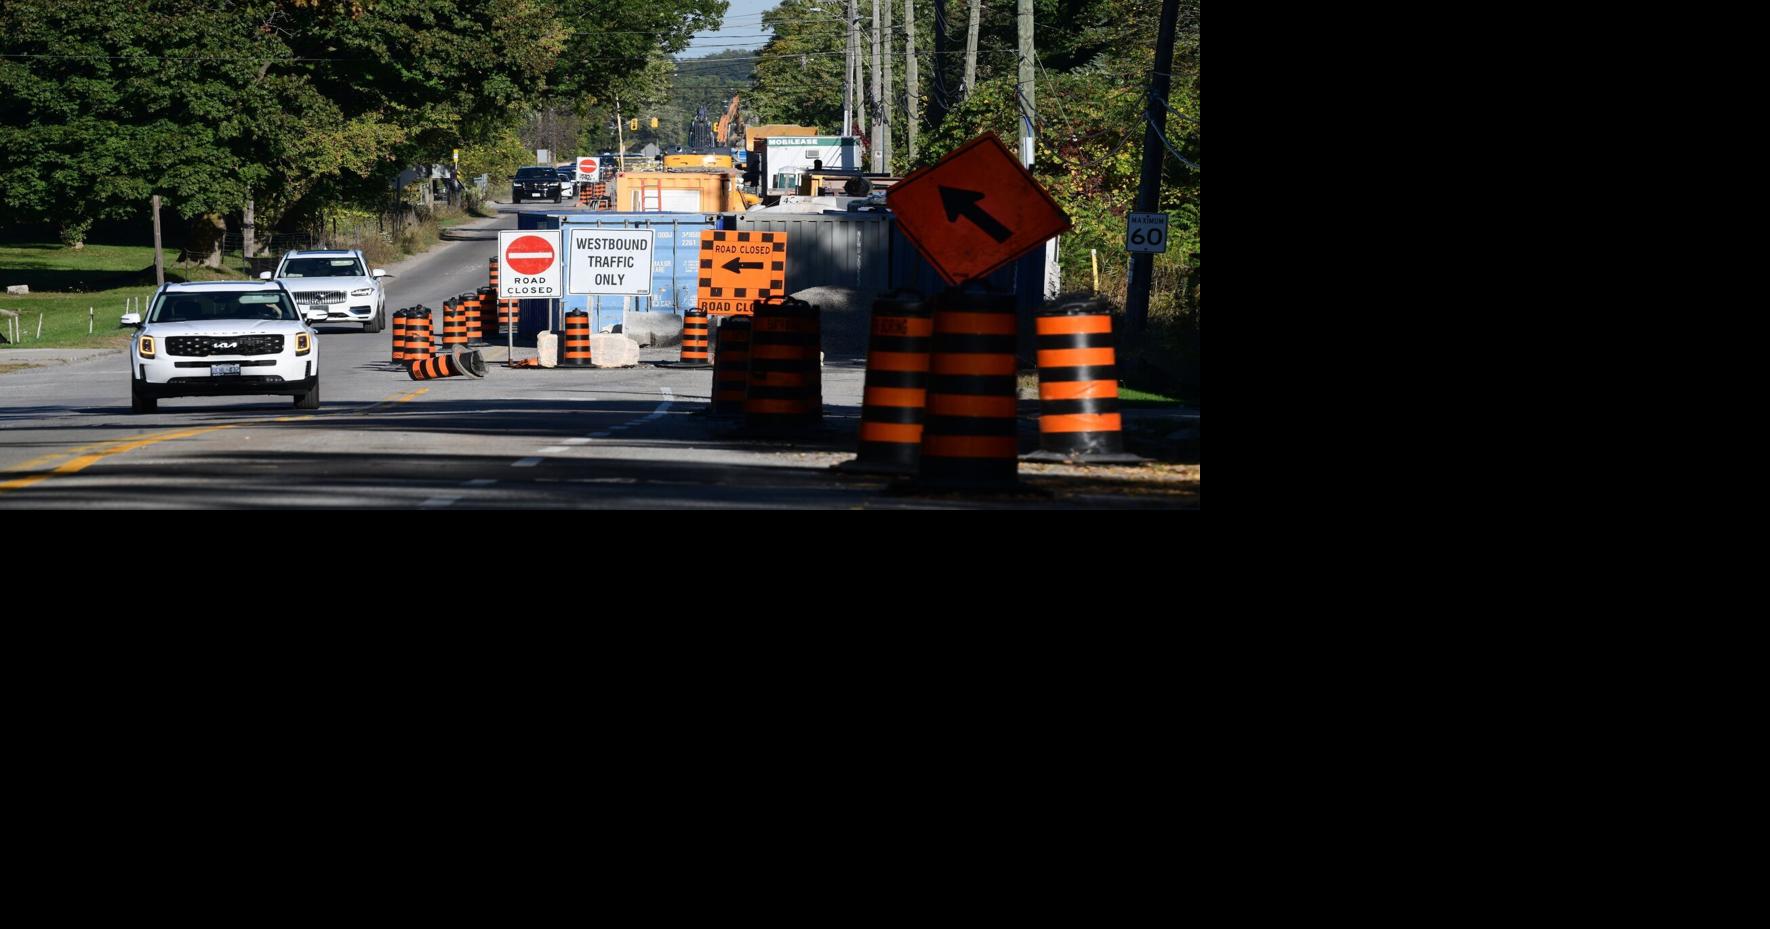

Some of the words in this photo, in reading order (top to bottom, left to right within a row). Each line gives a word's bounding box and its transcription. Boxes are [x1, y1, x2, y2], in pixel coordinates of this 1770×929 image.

[1131, 215, 1164, 225] MAXIMUM
[1131, 228, 1163, 245] 60
[576, 237, 648, 251] WESTBOUND
[715, 244, 737, 254] ROAD
[739, 245, 771, 255] CLOSED
[588, 255, 634, 268] TRAFFIC
[594, 273, 625, 286] ONLY
[507, 286, 553, 294] CLOSED
[701, 301, 731, 313] ROAD
